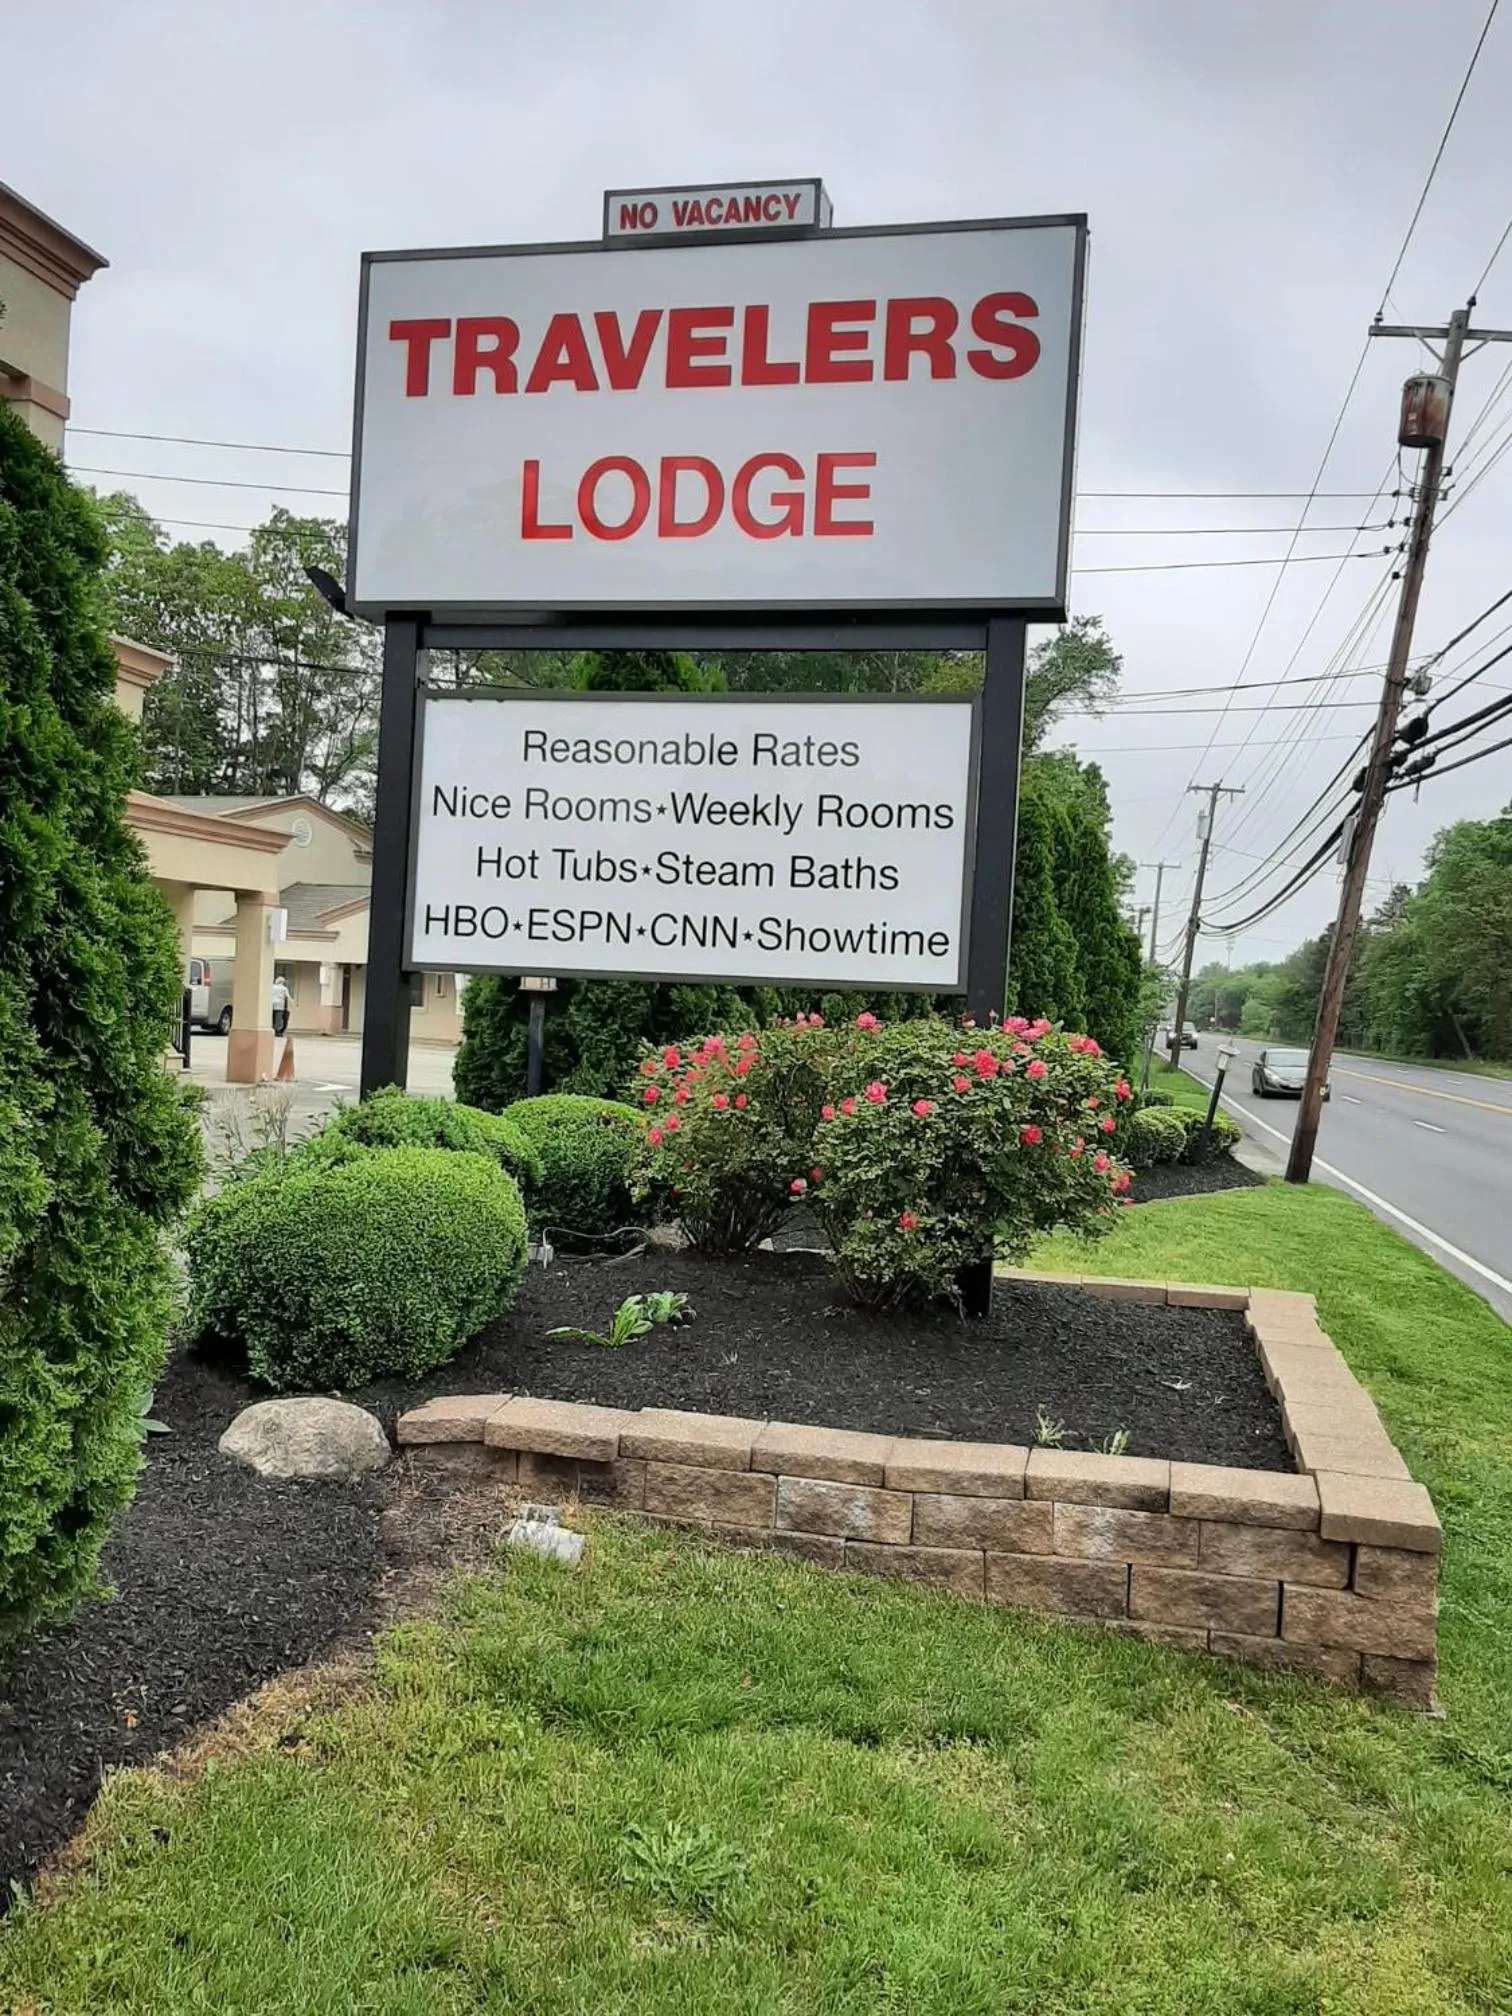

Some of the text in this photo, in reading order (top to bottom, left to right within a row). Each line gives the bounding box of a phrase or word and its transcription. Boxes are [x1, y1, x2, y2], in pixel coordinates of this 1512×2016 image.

[618, 192, 802, 231] NO VACANCY
[387, 293, 1040, 399] TRAVELERS
[519, 451, 877, 544] LODGE
[523, 729, 860, 769] Reasonable Rates
[433, 784, 954, 836] Nice Rooms Weekly Rooms
[476, 845, 899, 891] Hot Tubs Steam Baths
[424, 903, 950, 957] HBO ESPN CNN Showtime
